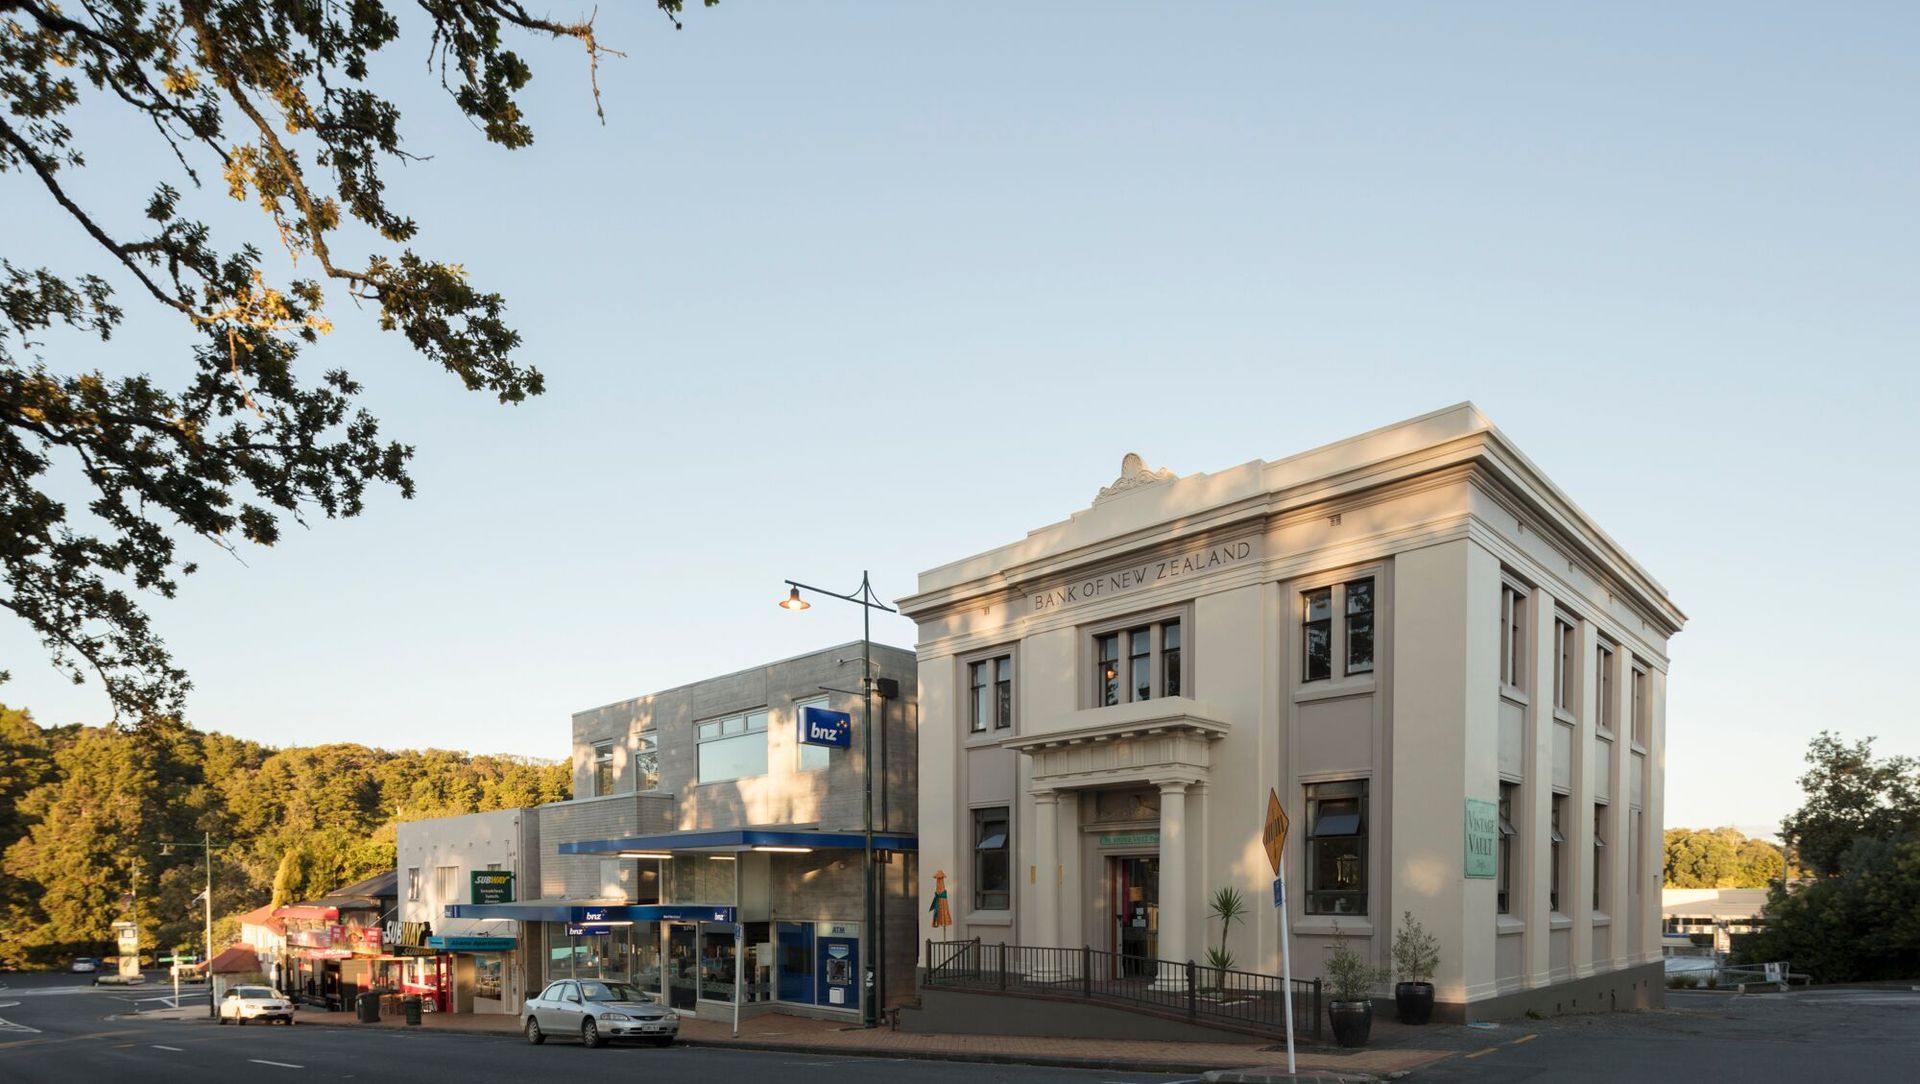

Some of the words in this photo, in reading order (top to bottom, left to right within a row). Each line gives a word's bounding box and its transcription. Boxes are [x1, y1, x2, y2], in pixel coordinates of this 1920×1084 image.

[1034, 586, 1077, 610] BANK
[1083, 579, 1104, 598] OF
[1110, 567, 1147, 592] NEW
[1156, 541, 1251, 580] ZEALAND
[811, 722, 838, 741] bnz
[1468, 833, 1493, 856] VAULT
[475, 876, 510, 884] SUBWAY
[586, 912, 601, 920] bnz
[383, 921, 425, 946] SUBWAY
[832, 926, 846, 934] ATM
